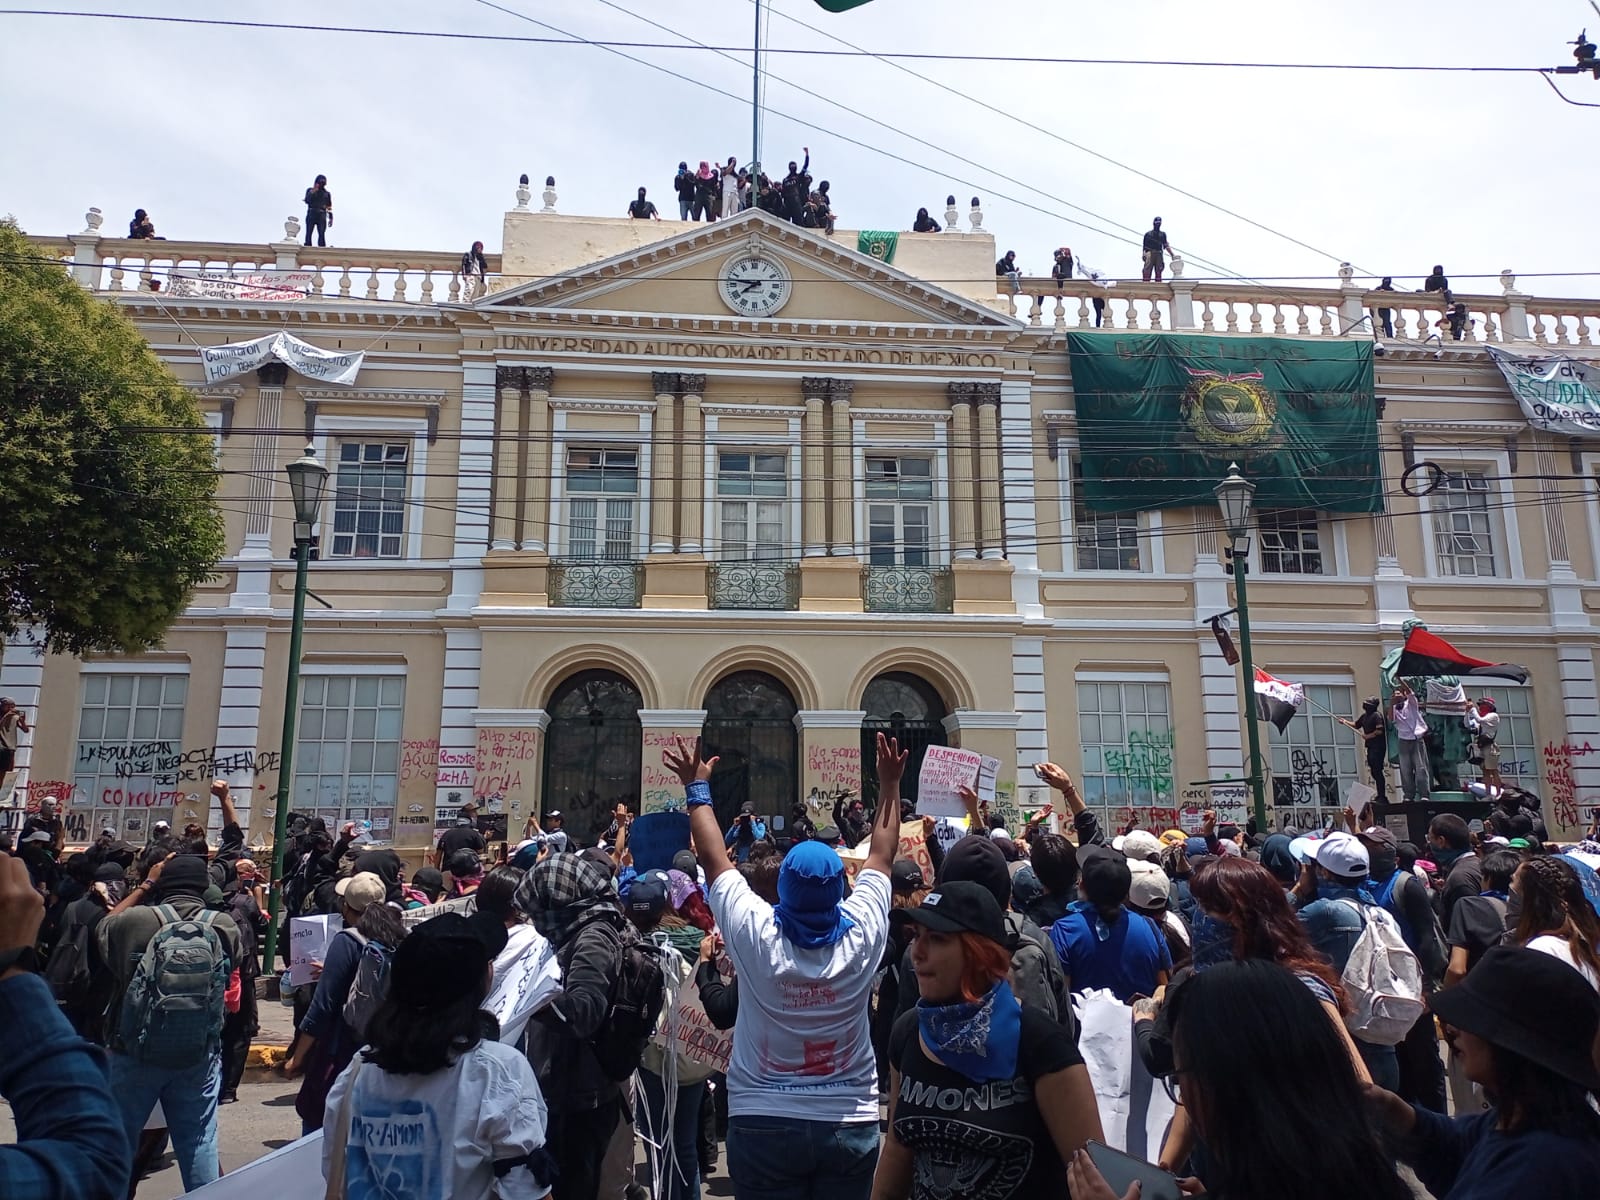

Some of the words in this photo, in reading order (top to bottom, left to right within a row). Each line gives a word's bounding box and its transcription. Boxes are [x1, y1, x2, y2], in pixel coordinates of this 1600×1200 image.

[502, 335, 644, 354] UNIVERSIDAD
[643, 341, 758, 360] AUTONOMA
[760, 346, 791, 361] DEL
[801, 348, 884, 364] ESTADO
[890, 351, 912, 365] DE
[920, 352, 997, 368] MEXICO
[899, 1075, 1034, 1112] AMONES
